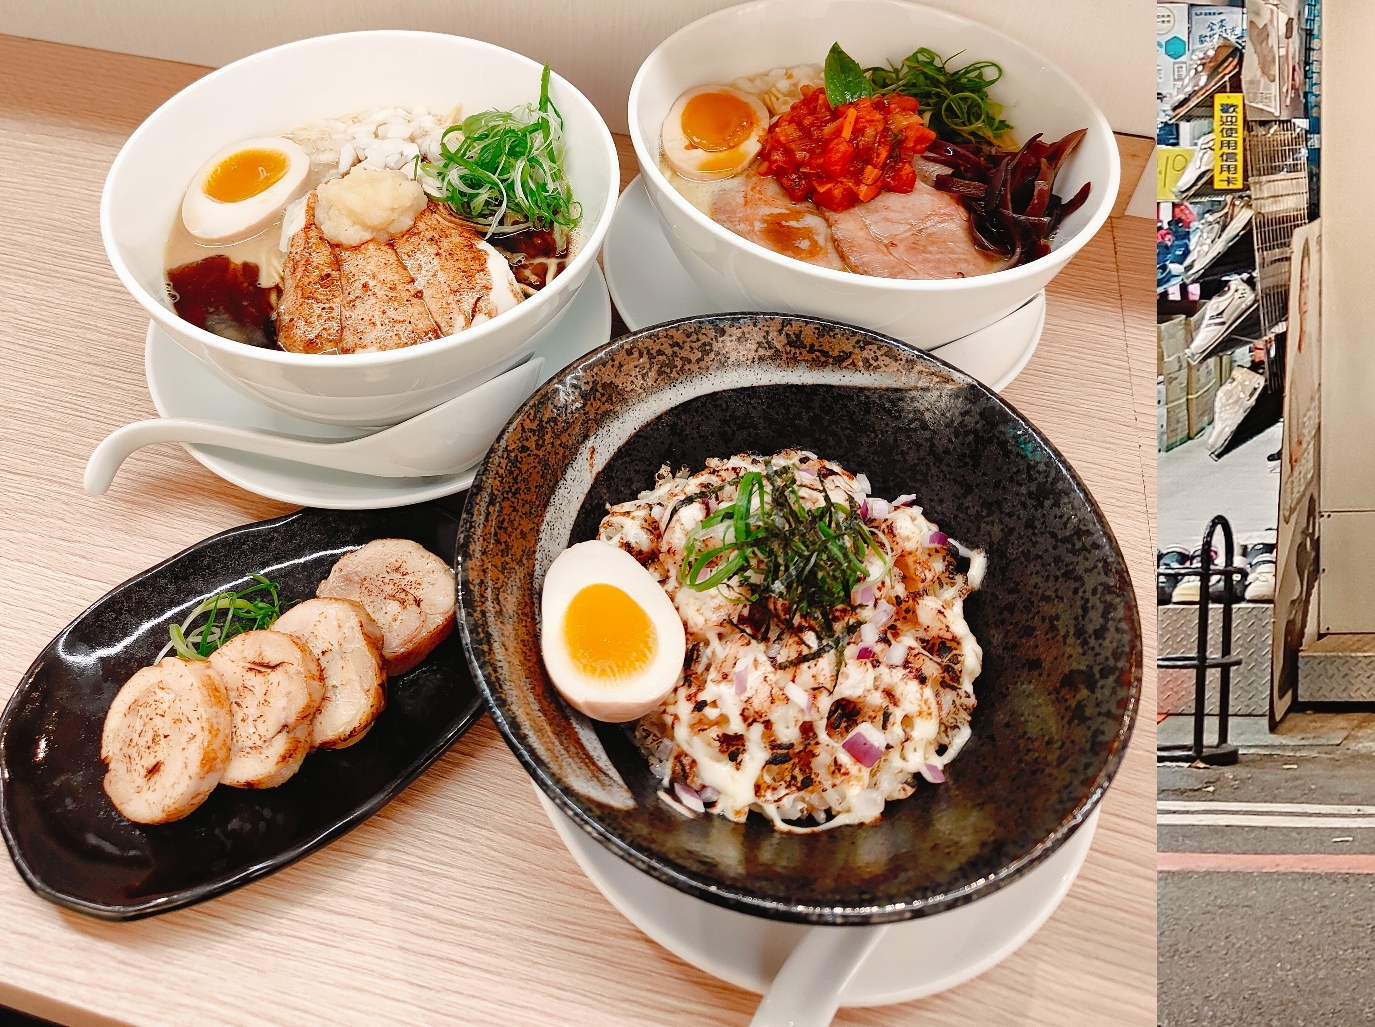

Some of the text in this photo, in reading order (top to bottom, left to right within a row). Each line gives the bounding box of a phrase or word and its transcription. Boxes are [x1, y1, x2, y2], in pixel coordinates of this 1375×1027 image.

[1219, 102, 1239, 187] 歡迎使用信用卡
